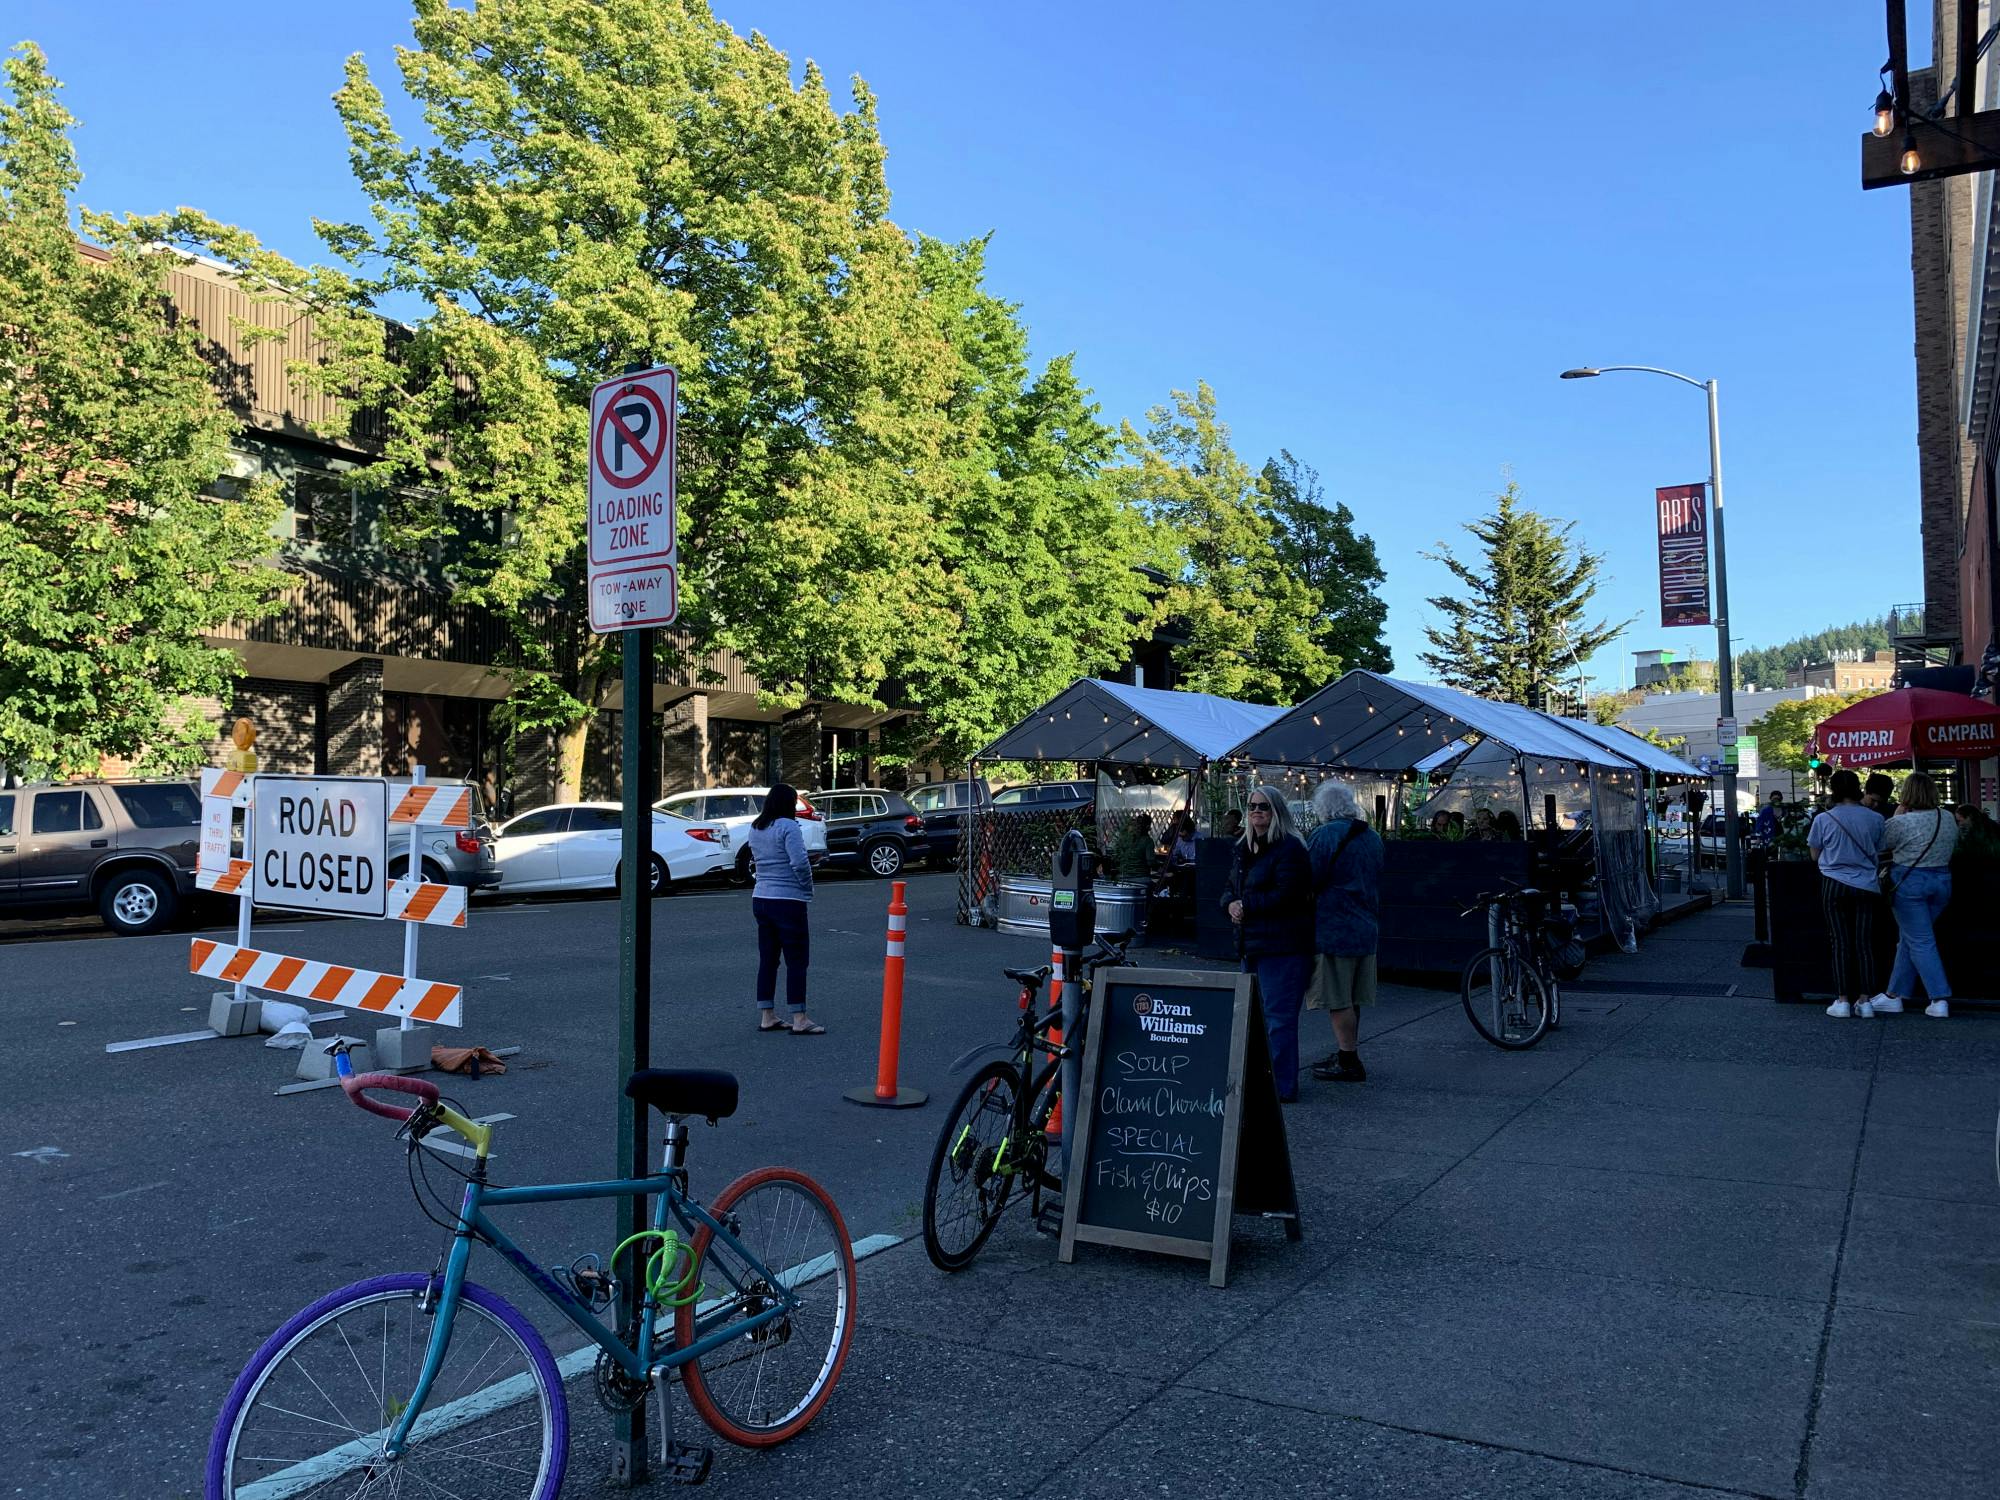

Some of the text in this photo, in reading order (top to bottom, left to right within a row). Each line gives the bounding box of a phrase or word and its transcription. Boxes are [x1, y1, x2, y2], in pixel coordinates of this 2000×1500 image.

[597, 492, 663, 525] LOADING
[1660, 496, 1702, 535] ARTS
[609, 523, 649, 551] ZONE
[1661, 536, 1706, 607] DISTRICT
[599, 576, 663, 596] TOW-AWAY
[614, 600, 647, 616] ZONE
[1827, 729, 1895, 749] CAMPARI
[1927, 722, 1995, 743] CAMPARI
[279, 796, 357, 838] ROAD
[204, 841, 227, 855] TRAFFIC
[264, 850, 373, 895] CLOSED
[1151, 999, 1192, 1016] Evan
[1139, 1015, 1204, 1035] Williams
[1150, 1033, 1189, 1044] Bourbon
[1117, 1051, 1190, 1075] SOUP
[1101, 1086, 1152, 1115] Clam
[1107, 1126, 1203, 1155] SPECIAL
[1096, 1158, 1136, 1189] Fish
[1153, 1161, 1212, 1204] Chips
[1146, 1197, 1183, 1224] $10
